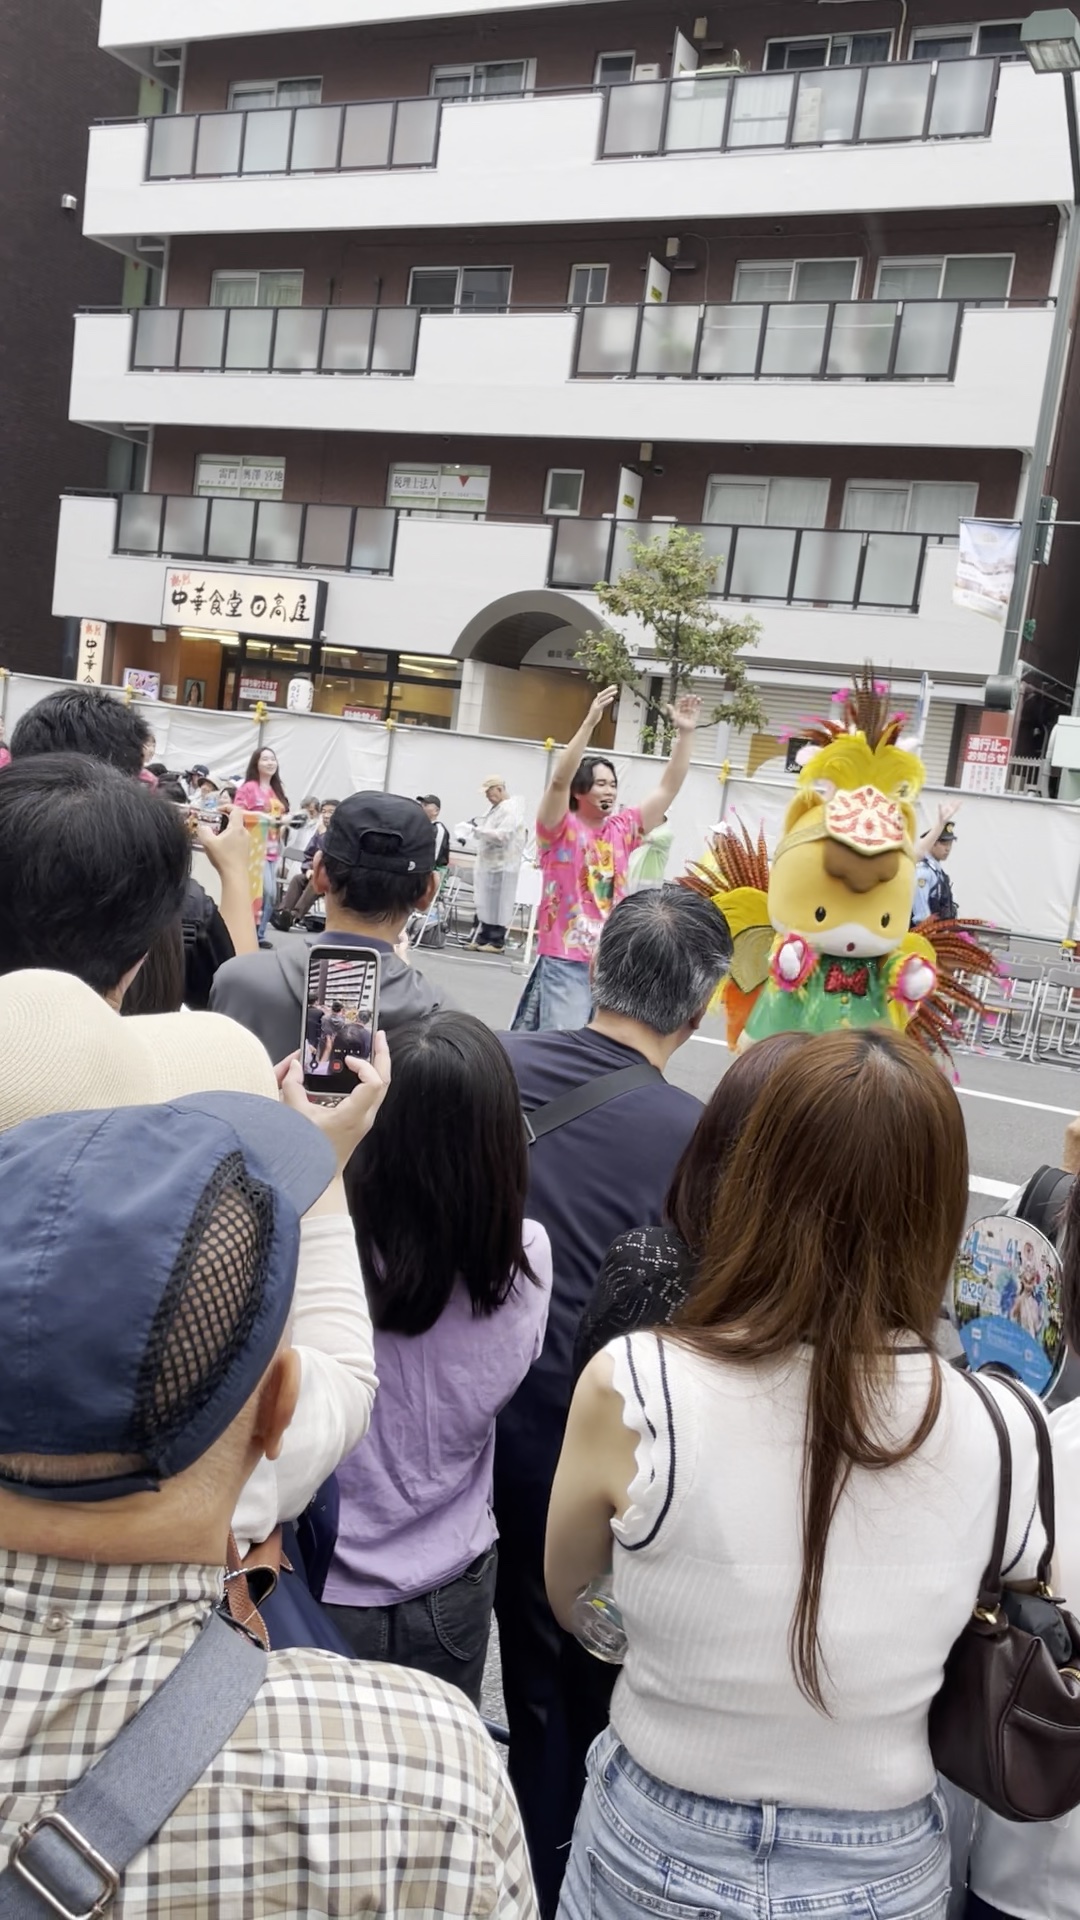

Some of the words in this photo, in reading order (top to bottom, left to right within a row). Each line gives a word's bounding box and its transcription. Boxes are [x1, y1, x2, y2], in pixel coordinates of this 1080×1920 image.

[393, 475, 437, 490] 税理士法人
[171, 582, 243, 618] 中華食堂
[250, 592, 310, 622] 日高屋
[968, 736, 1008, 753] 通行止の
[966, 751, 1007, 765] お知らせ
